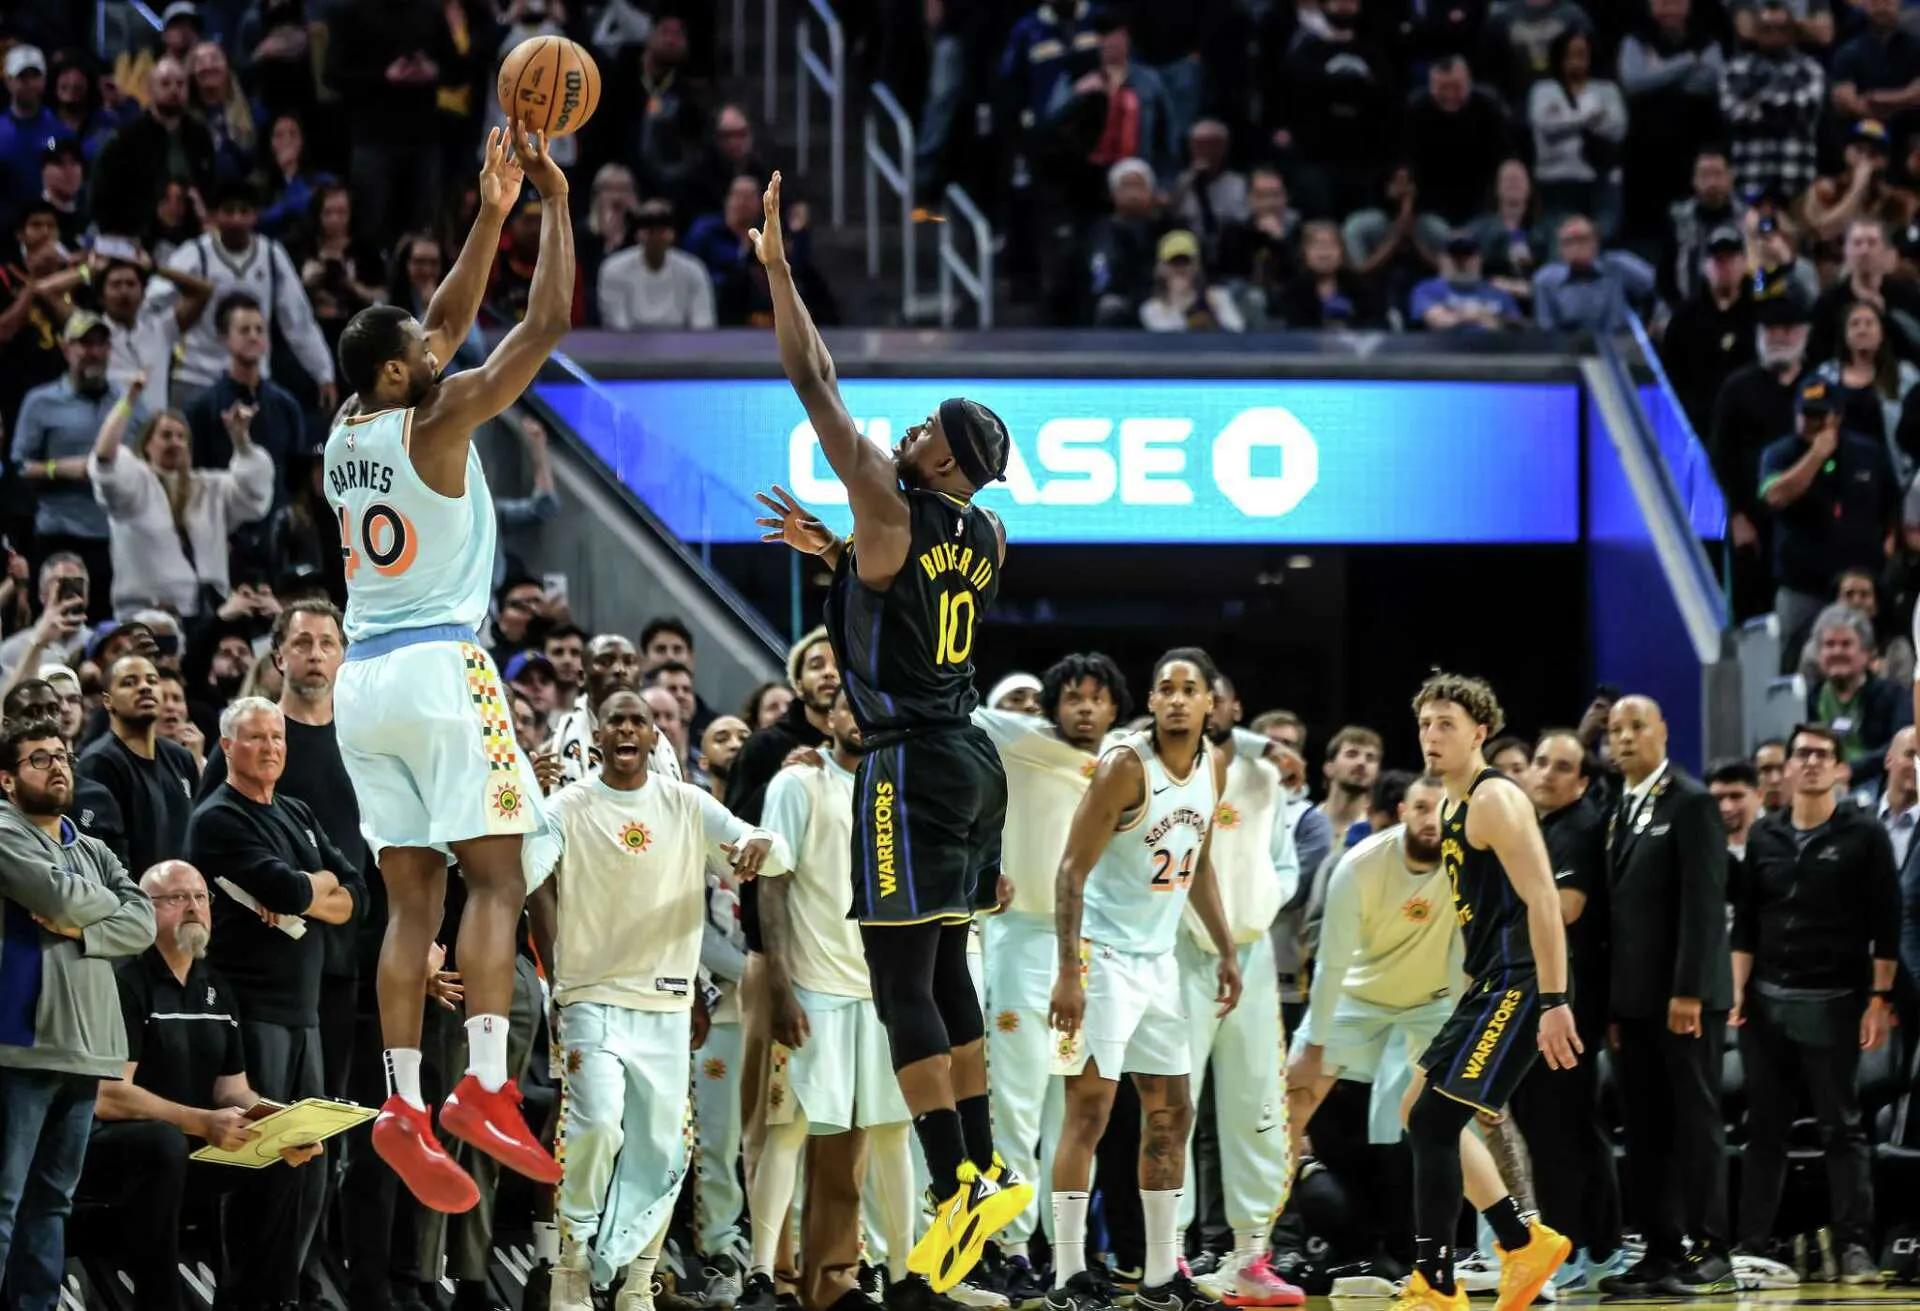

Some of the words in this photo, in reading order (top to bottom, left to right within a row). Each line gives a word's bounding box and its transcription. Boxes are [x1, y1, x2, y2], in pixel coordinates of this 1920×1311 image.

[329, 459, 394, 496] BARNES
[789, 417, 1194, 505] CSE
[936, 589, 975, 665] 10
[875, 781, 897, 899] WARRIORS
[1151, 848, 1195, 890] 24
[1461, 989, 1522, 1079] WARRIORS
